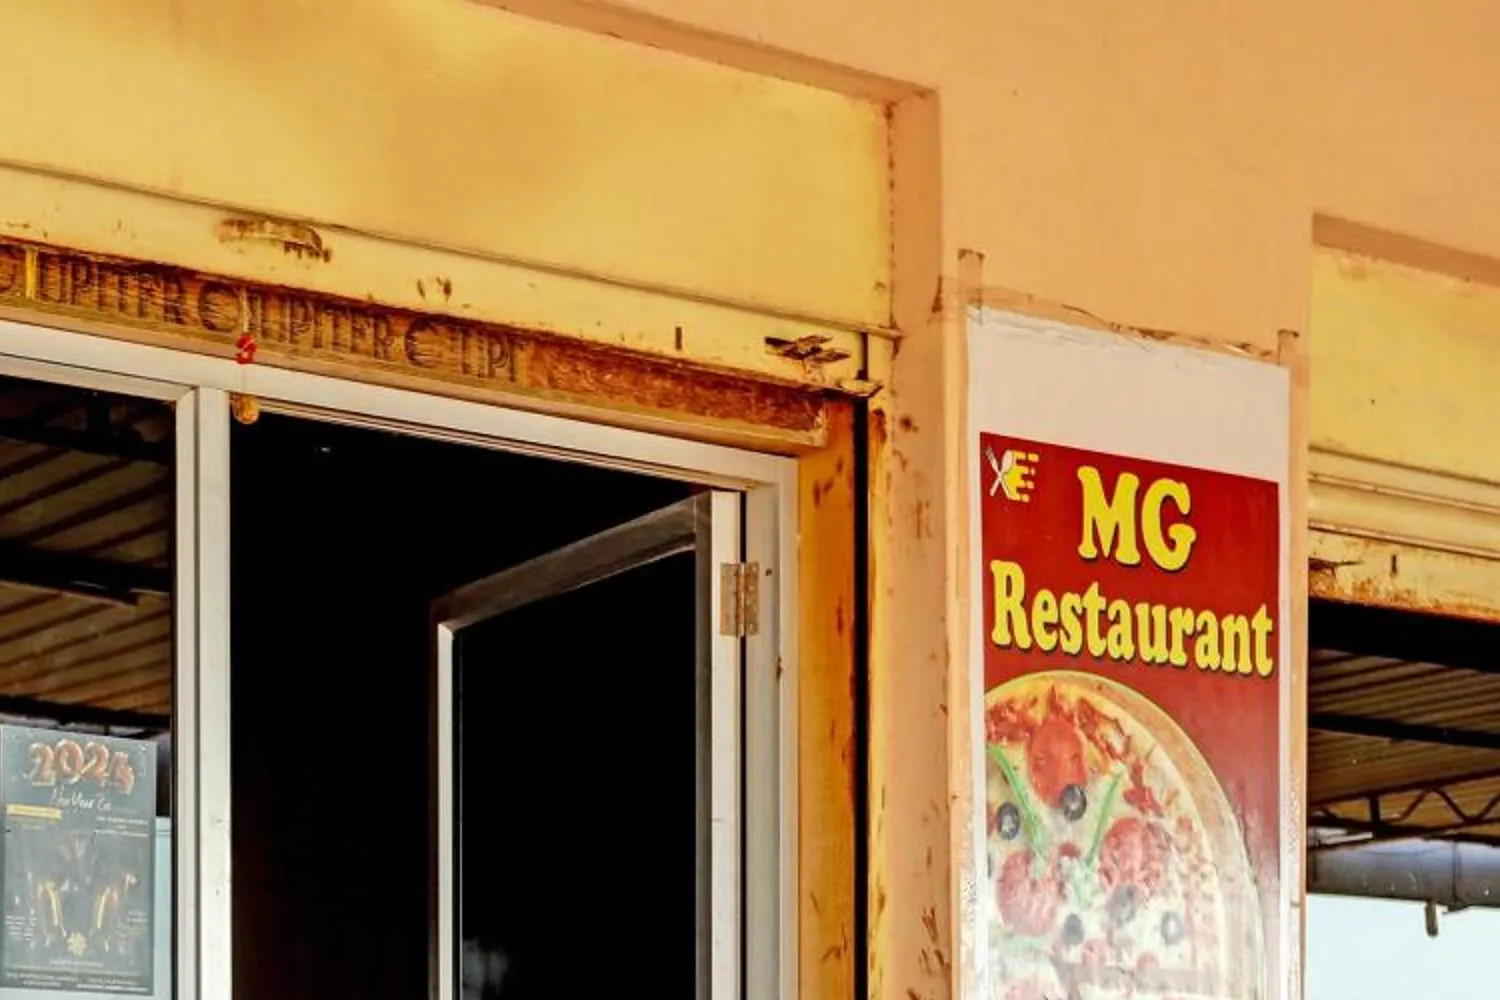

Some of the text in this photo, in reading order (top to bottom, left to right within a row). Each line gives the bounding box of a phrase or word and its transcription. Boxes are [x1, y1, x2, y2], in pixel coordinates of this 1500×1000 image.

[25, 248, 186, 325] UPITER
[1077, 465, 1197, 572] MG
[990, 559, 1273, 678] Restaurant
